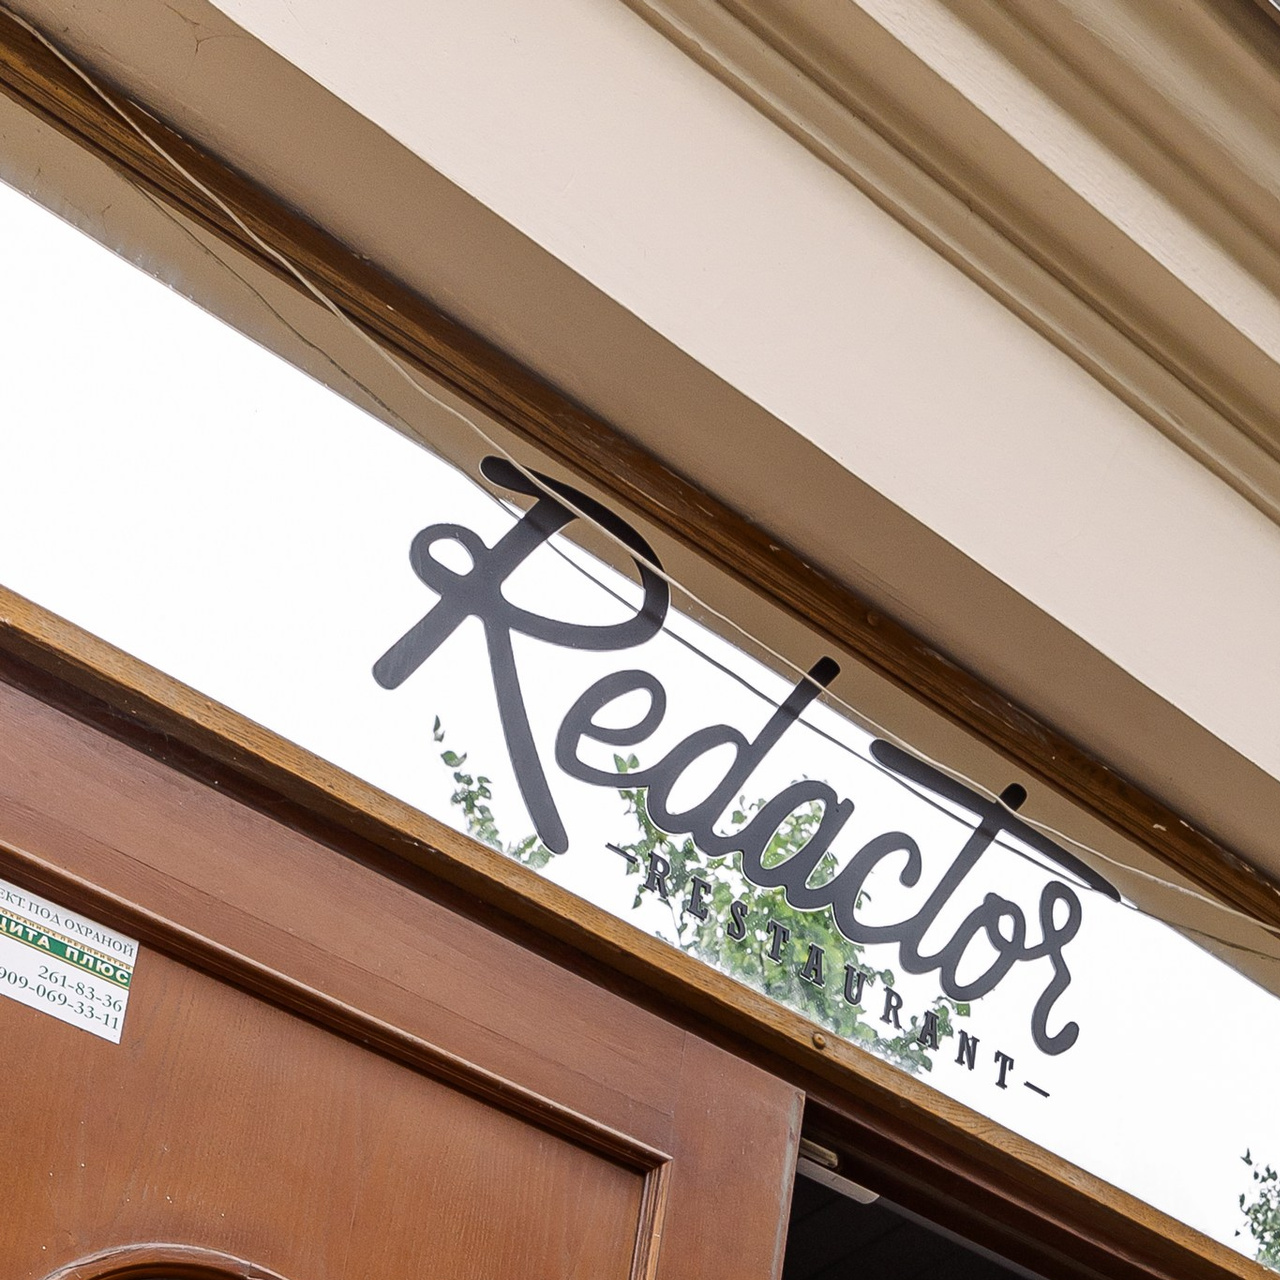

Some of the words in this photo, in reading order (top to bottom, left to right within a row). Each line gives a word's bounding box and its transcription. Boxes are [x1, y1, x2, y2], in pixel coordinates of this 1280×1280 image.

[372, 456, 1121, 1056] Redactor
[29, 901, 61, 927] ПОД
[64, 918, 134, 957] ОХРАНОЙ
[38, 965, 123, 1012] 261-83-36
[65, 946, 129, 984] ПЛЮС
[643, 850, 1015, 1090] RESTAURANT
